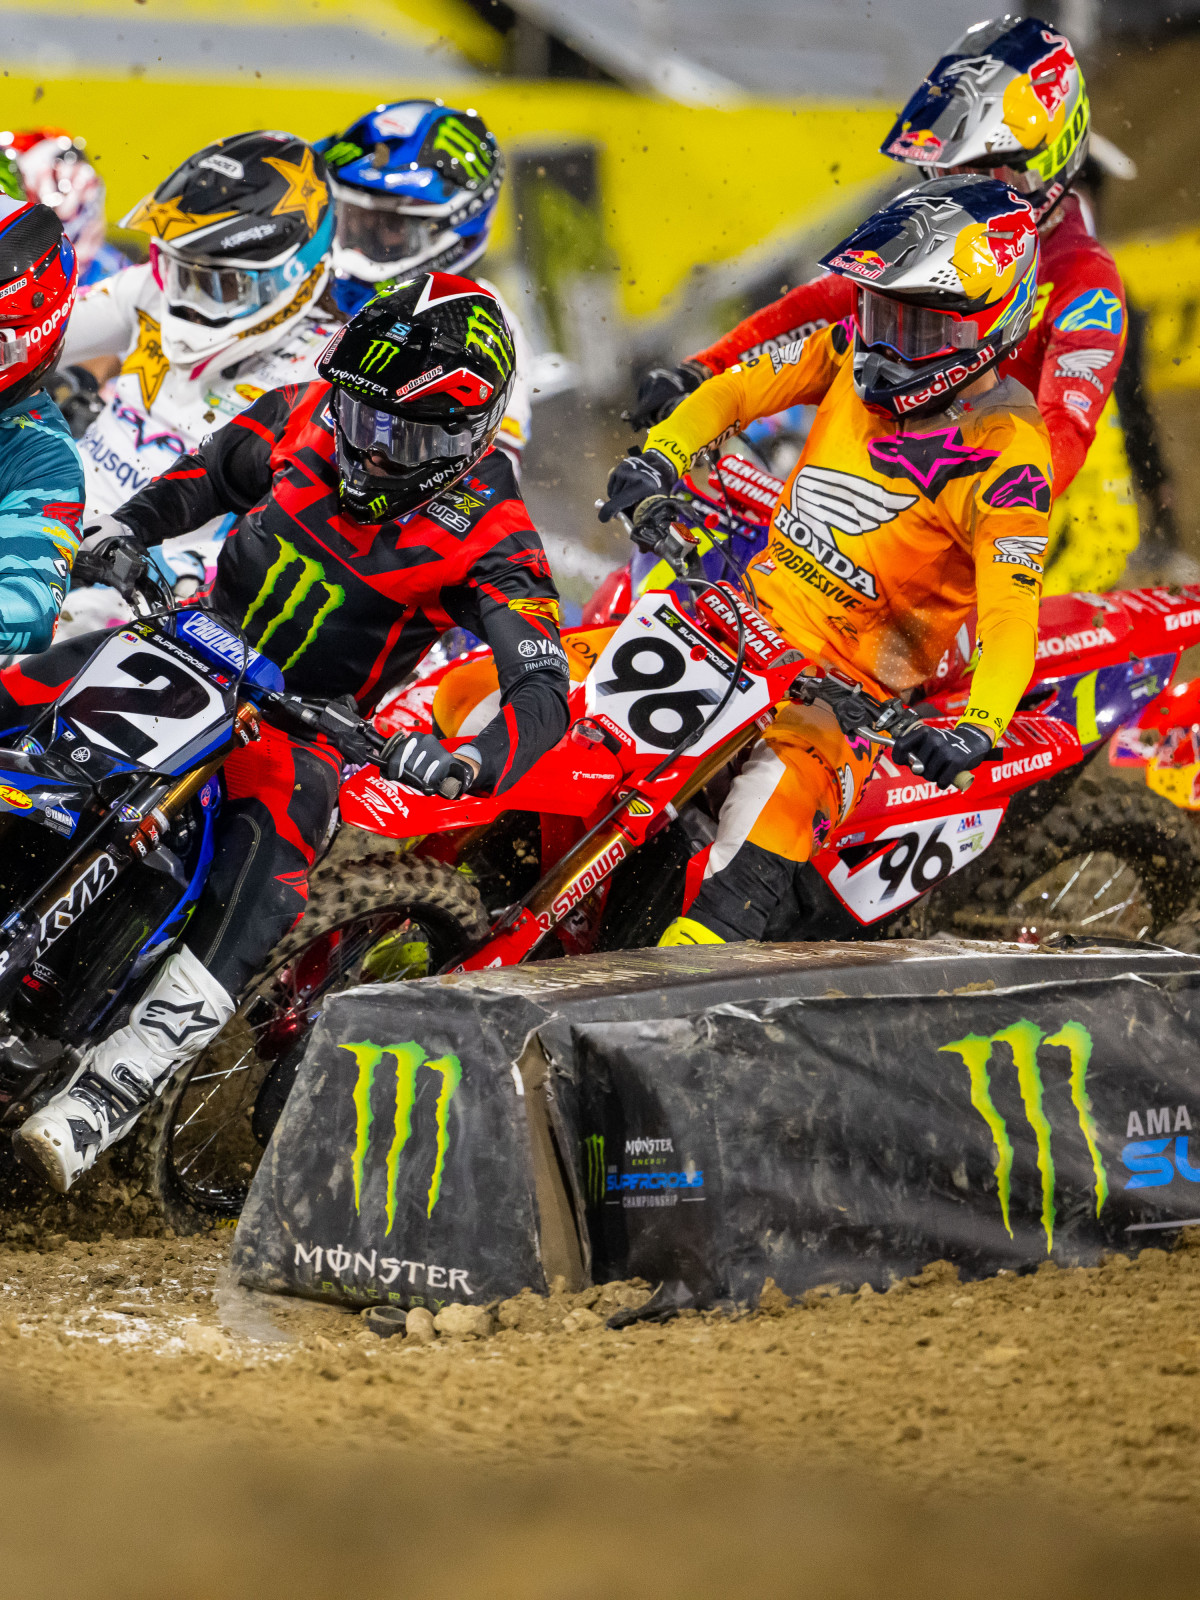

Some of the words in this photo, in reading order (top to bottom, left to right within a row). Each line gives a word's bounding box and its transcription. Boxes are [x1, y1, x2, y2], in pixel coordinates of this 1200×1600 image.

[328, 367, 389, 396] MONSTER
[332, 378, 376, 396] ENERGY
[427, 501, 471, 532] WPS
[774, 506, 879, 600] HONDA
[993, 553, 1044, 574] HOND
[152, 633, 210, 673] SUPERCROSS
[58, 651, 211, 759] 2
[595, 636, 722, 751] 96
[1072, 669, 1101, 745] 1
[599, 715, 632, 747] HONDA
[991, 751, 1053, 783] DUNLOP
[365, 775, 410, 819] HONDA
[956, 812, 984, 834] AMA
[878, 820, 953, 906] 96
[550, 841, 627, 922] SHOWA
[1126, 1105, 1193, 1138] AMA
[625, 1136, 674, 1157] MONSTER
[631, 1158, 667, 1166] ENERGY
[606, 1170, 704, 1191] SUPERCROSS
[622, 1194, 678, 1209] CHAMPIONSHIP
[293, 1242, 475, 1296] MONSTER
